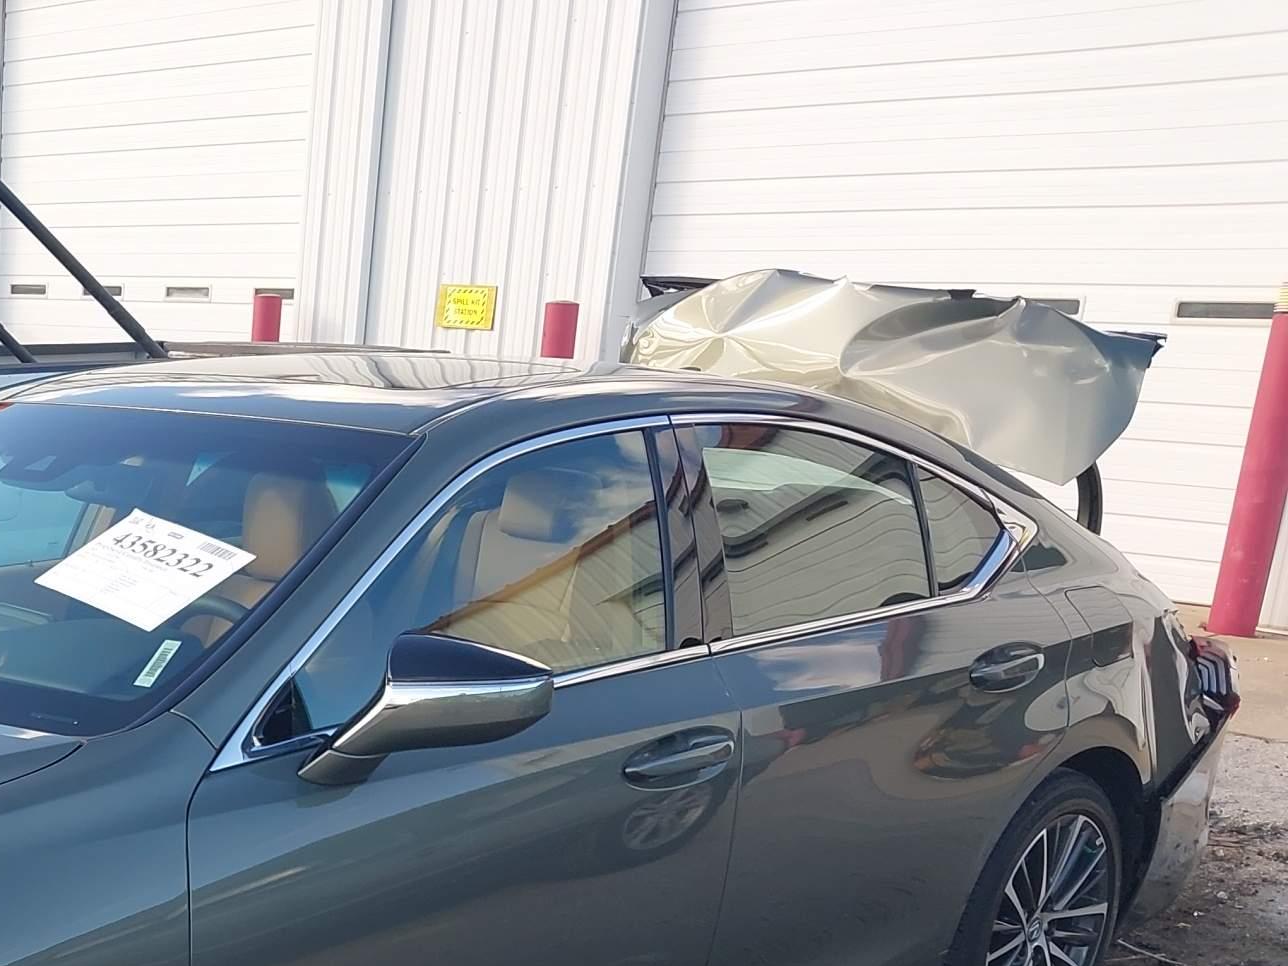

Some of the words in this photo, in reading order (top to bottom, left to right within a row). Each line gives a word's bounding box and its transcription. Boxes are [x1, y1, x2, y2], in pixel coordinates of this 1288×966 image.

[452, 298, 469, 306] SPILL
[454, 308, 478, 316] STATION
[113, 532, 214, 578] 43582322
